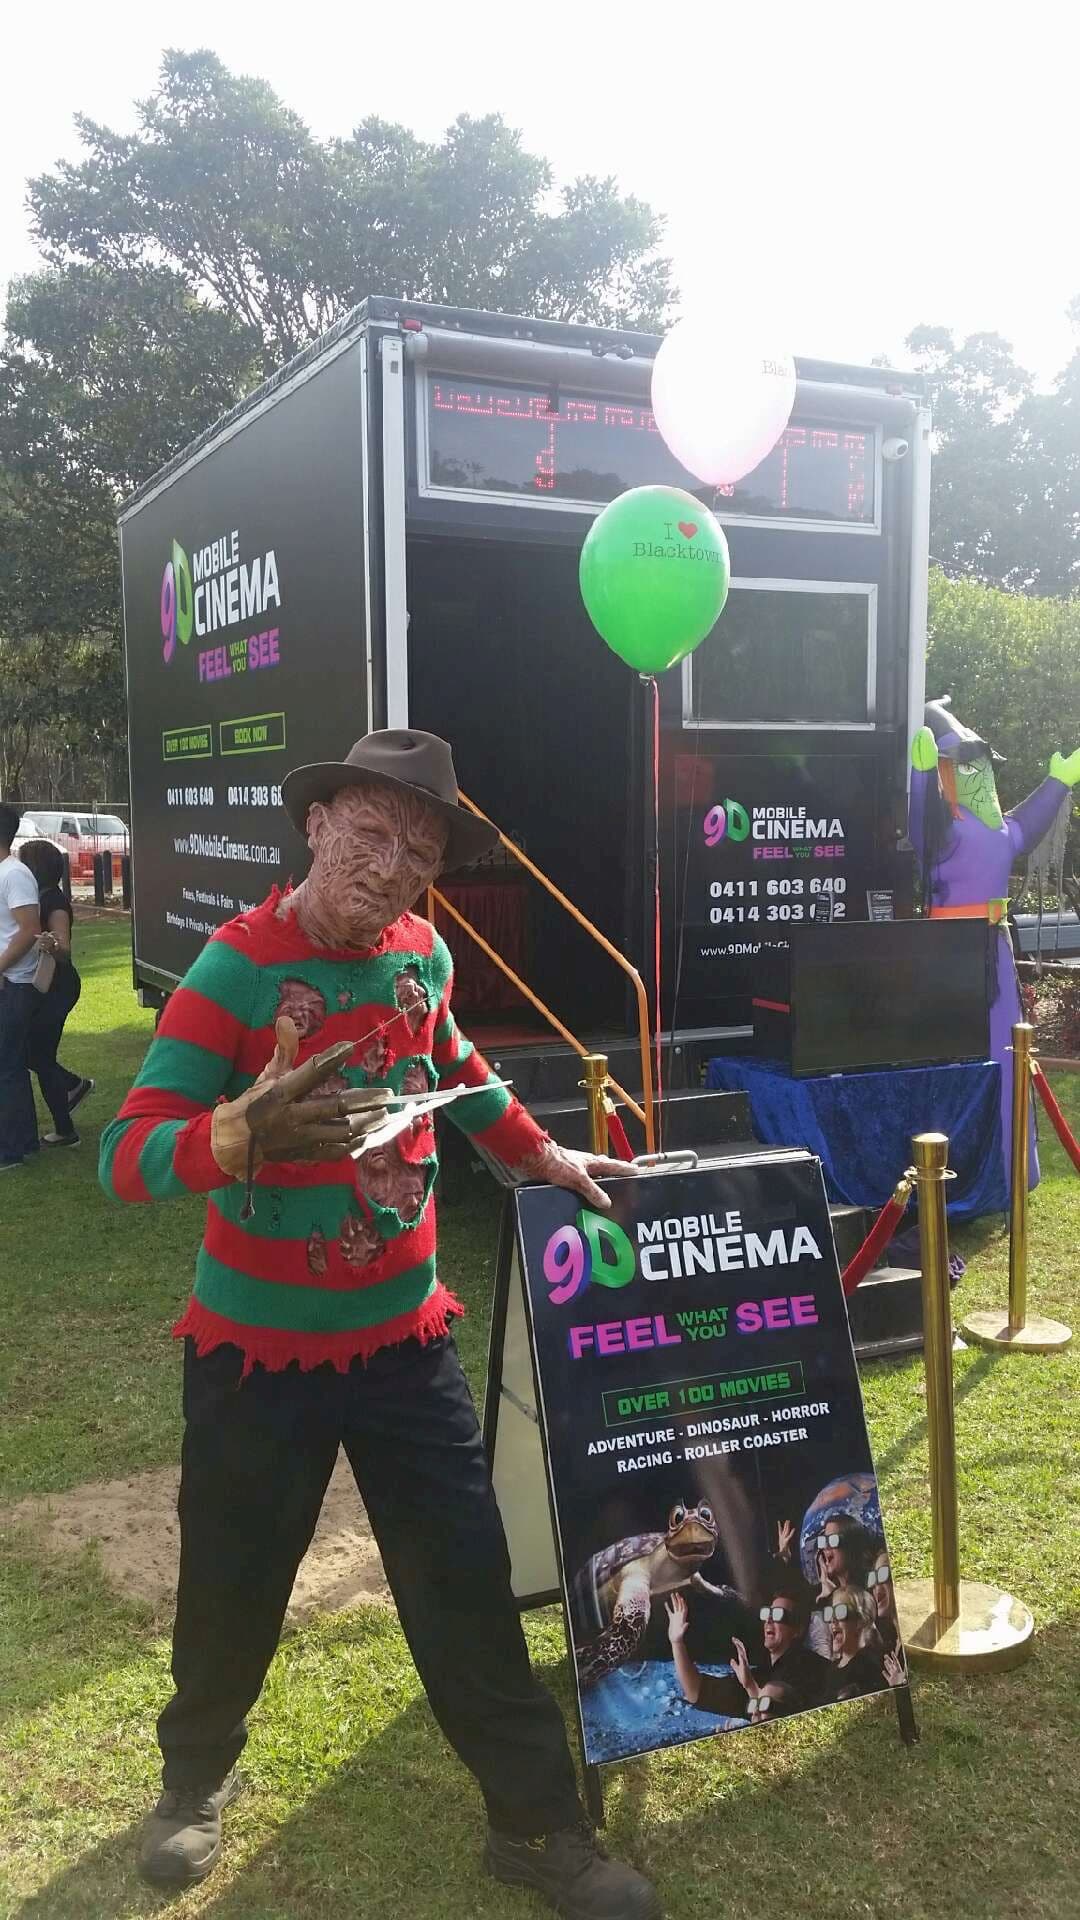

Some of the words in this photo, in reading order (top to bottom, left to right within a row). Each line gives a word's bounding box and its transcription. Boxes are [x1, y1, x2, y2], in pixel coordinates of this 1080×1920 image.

[664, 523, 673, 540] I
[193, 529, 239, 583] MOBILE
[160, 538, 193, 664] 9D
[194, 550, 281, 636] CINEMA
[229, 639, 248, 656] WHAT
[249, 628, 280, 669] SEE
[199, 646, 231, 683] FEEL
[233, 657, 246, 673] YOU
[234, 727, 251, 744] BOOK
[252, 725, 268, 742] NOW
[167, 788, 183, 805] 0411
[185, 787, 198, 805] 603
[199, 787, 214, 805] 640
[228, 786, 249, 806] 0414
[251, 786, 269, 806] 303
[703, 798, 750, 847] 9D
[752, 807, 806, 819] MOBILE
[752, 818, 845, 840] CINEMA
[173, 834, 281, 864] www.9DMobileCinema.com.au
[753, 846, 793, 860] FEEL
[814, 845, 845, 858] SEE
[220, 894, 234, 909] Fairs
[710, 880, 759, 898] 0411
[766, 878, 804, 896] 603
[809, 877, 846, 894] 640
[166, 911, 185, 929] Birthdays
[709, 905, 760, 923] 0414
[766, 904, 804, 921] 303
[636, 1210, 743, 1243] MOBILE
[543, 1207, 636, 1305] 9D
[639, 1225, 823, 1281] CINEMA
[676, 1306, 729, 1327] WHAT
[735, 1294, 819, 1335] SEE
[567, 1315, 682, 1360] FEEL
[686, 1323, 727, 1342] YOU
[617, 1391, 670, 1416] OVER
[679, 1384, 715, 1405] 100
[719, 1372, 791, 1399] MOVIES
[587, 1428, 676, 1455] ADVENTURE
[686, 1413, 760, 1438] DINOSAUR
[771, 1402, 830, 1423] HORROR
[616, 1451, 673, 1473] RACING
[684, 1439, 741, 1461] ROLLER
[743, 1428, 809, 1449] COASTER
